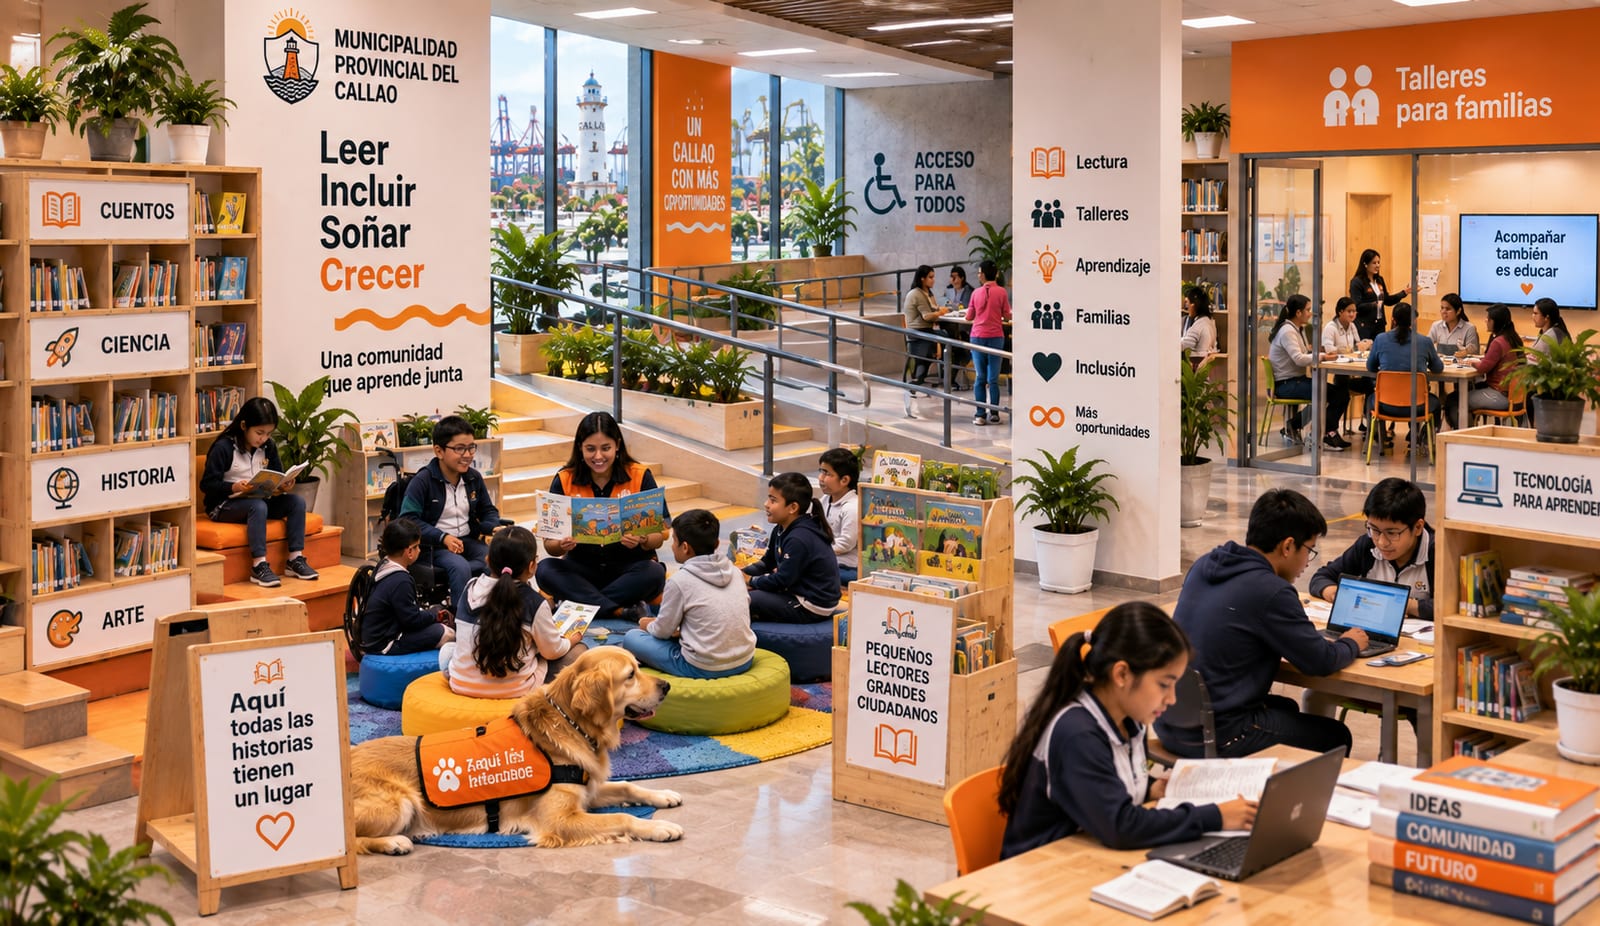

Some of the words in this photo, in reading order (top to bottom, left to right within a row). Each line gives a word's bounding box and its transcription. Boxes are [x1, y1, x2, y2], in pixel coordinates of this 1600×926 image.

[335, 28, 457, 59] MUNICIPALIDAD
[335, 54, 429, 81] PROVINCIAL
[432, 63, 459, 84] DEL
[1396, 64, 1487, 91] Talleres
[335, 81, 398, 104] CALLAO
[1397, 102, 1448, 128] para
[1455, 91, 1552, 120] familias
[687, 116, 702, 137] UN
[321, 130, 389, 166] Leer
[673, 141, 715, 164] CALLAO
[915, 150, 975, 169] ACCESO
[1077, 155, 1128, 169] Lectura
[321, 173, 416, 207] Incluir
[672, 168, 694, 189] CON
[697, 166, 719, 190] MÁS
[915, 173, 956, 191] PARA
[100, 202, 175, 220] CUENTOS
[914, 195, 965, 213] TODOS
[1076, 206, 1129, 221] Talleres
[320, 215, 411, 249] Soñar
[1494, 230, 1566, 246] Acompañar
[1496, 246, 1548, 260] también
[320, 257, 425, 292] Crecer
[1075, 257, 1151, 277] Aprendizaje
[1496, 266, 1511, 276] es
[1514, 263, 1559, 278] educar
[1076, 308, 1130, 326] Familias
[101, 333, 171, 354] CIENCIA
[321, 350, 353, 370] Una
[357, 342, 443, 366] comunidad
[1076, 359, 1136, 378] Inclusión
[322, 376, 352, 398] que
[356, 368, 421, 393] aprende
[424, 366, 463, 389] junta
[1076, 405, 1098, 419] Más
[1075, 423, 1150, 439] oportunidades
[101, 466, 175, 491] HISTORIA
[1513, 471, 1593, 495] TECNOLOGÍA
[1513, 493, 1543, 510] PARA
[102, 605, 144, 630] ARTE
[866, 640, 933, 666] PEQUEÑOS
[867, 659, 929, 684] LECTORES
[230, 686, 286, 714] Aquí
[867, 679, 926, 703] GRANDES
[857, 695, 938, 724] CIUDADANOS
[230, 715, 283, 737] todas
[288, 711, 314, 729] las
[232, 735, 313, 761] historias
[232, 762, 294, 784] tienen
[235, 791, 259, 808] un
[264, 782, 313, 805] lugar
[1410, 793, 1462, 819] IDEAS
[1405, 822, 1516, 861] COMUNIDAD
[1405, 850, 1478, 883] FUTURO
